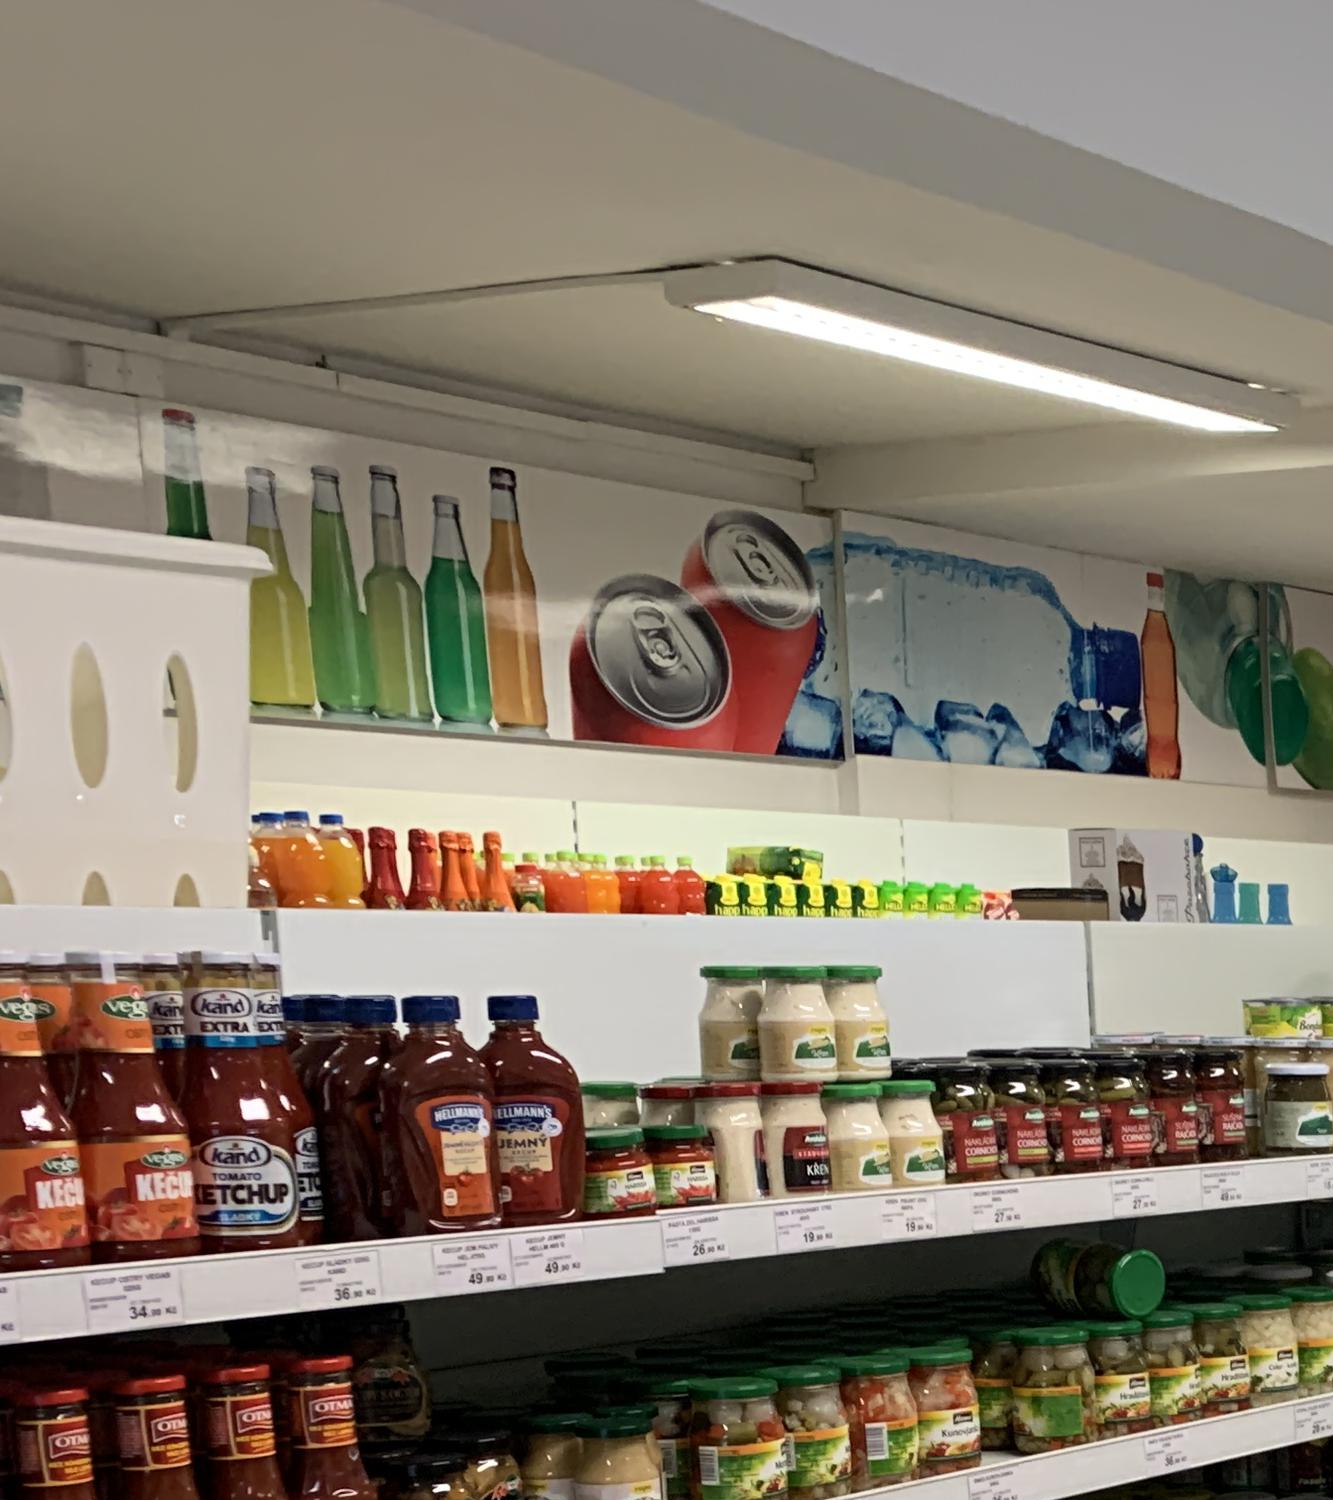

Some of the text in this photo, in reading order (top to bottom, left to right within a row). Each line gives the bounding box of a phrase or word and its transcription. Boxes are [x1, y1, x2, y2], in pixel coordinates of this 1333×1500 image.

[200, 999, 245, 1016] kand
[200, 1021, 249, 1034] EXTRA
[212, 1148, 260, 1167] kand
[212, 1172, 261, 1182] TOMATO
